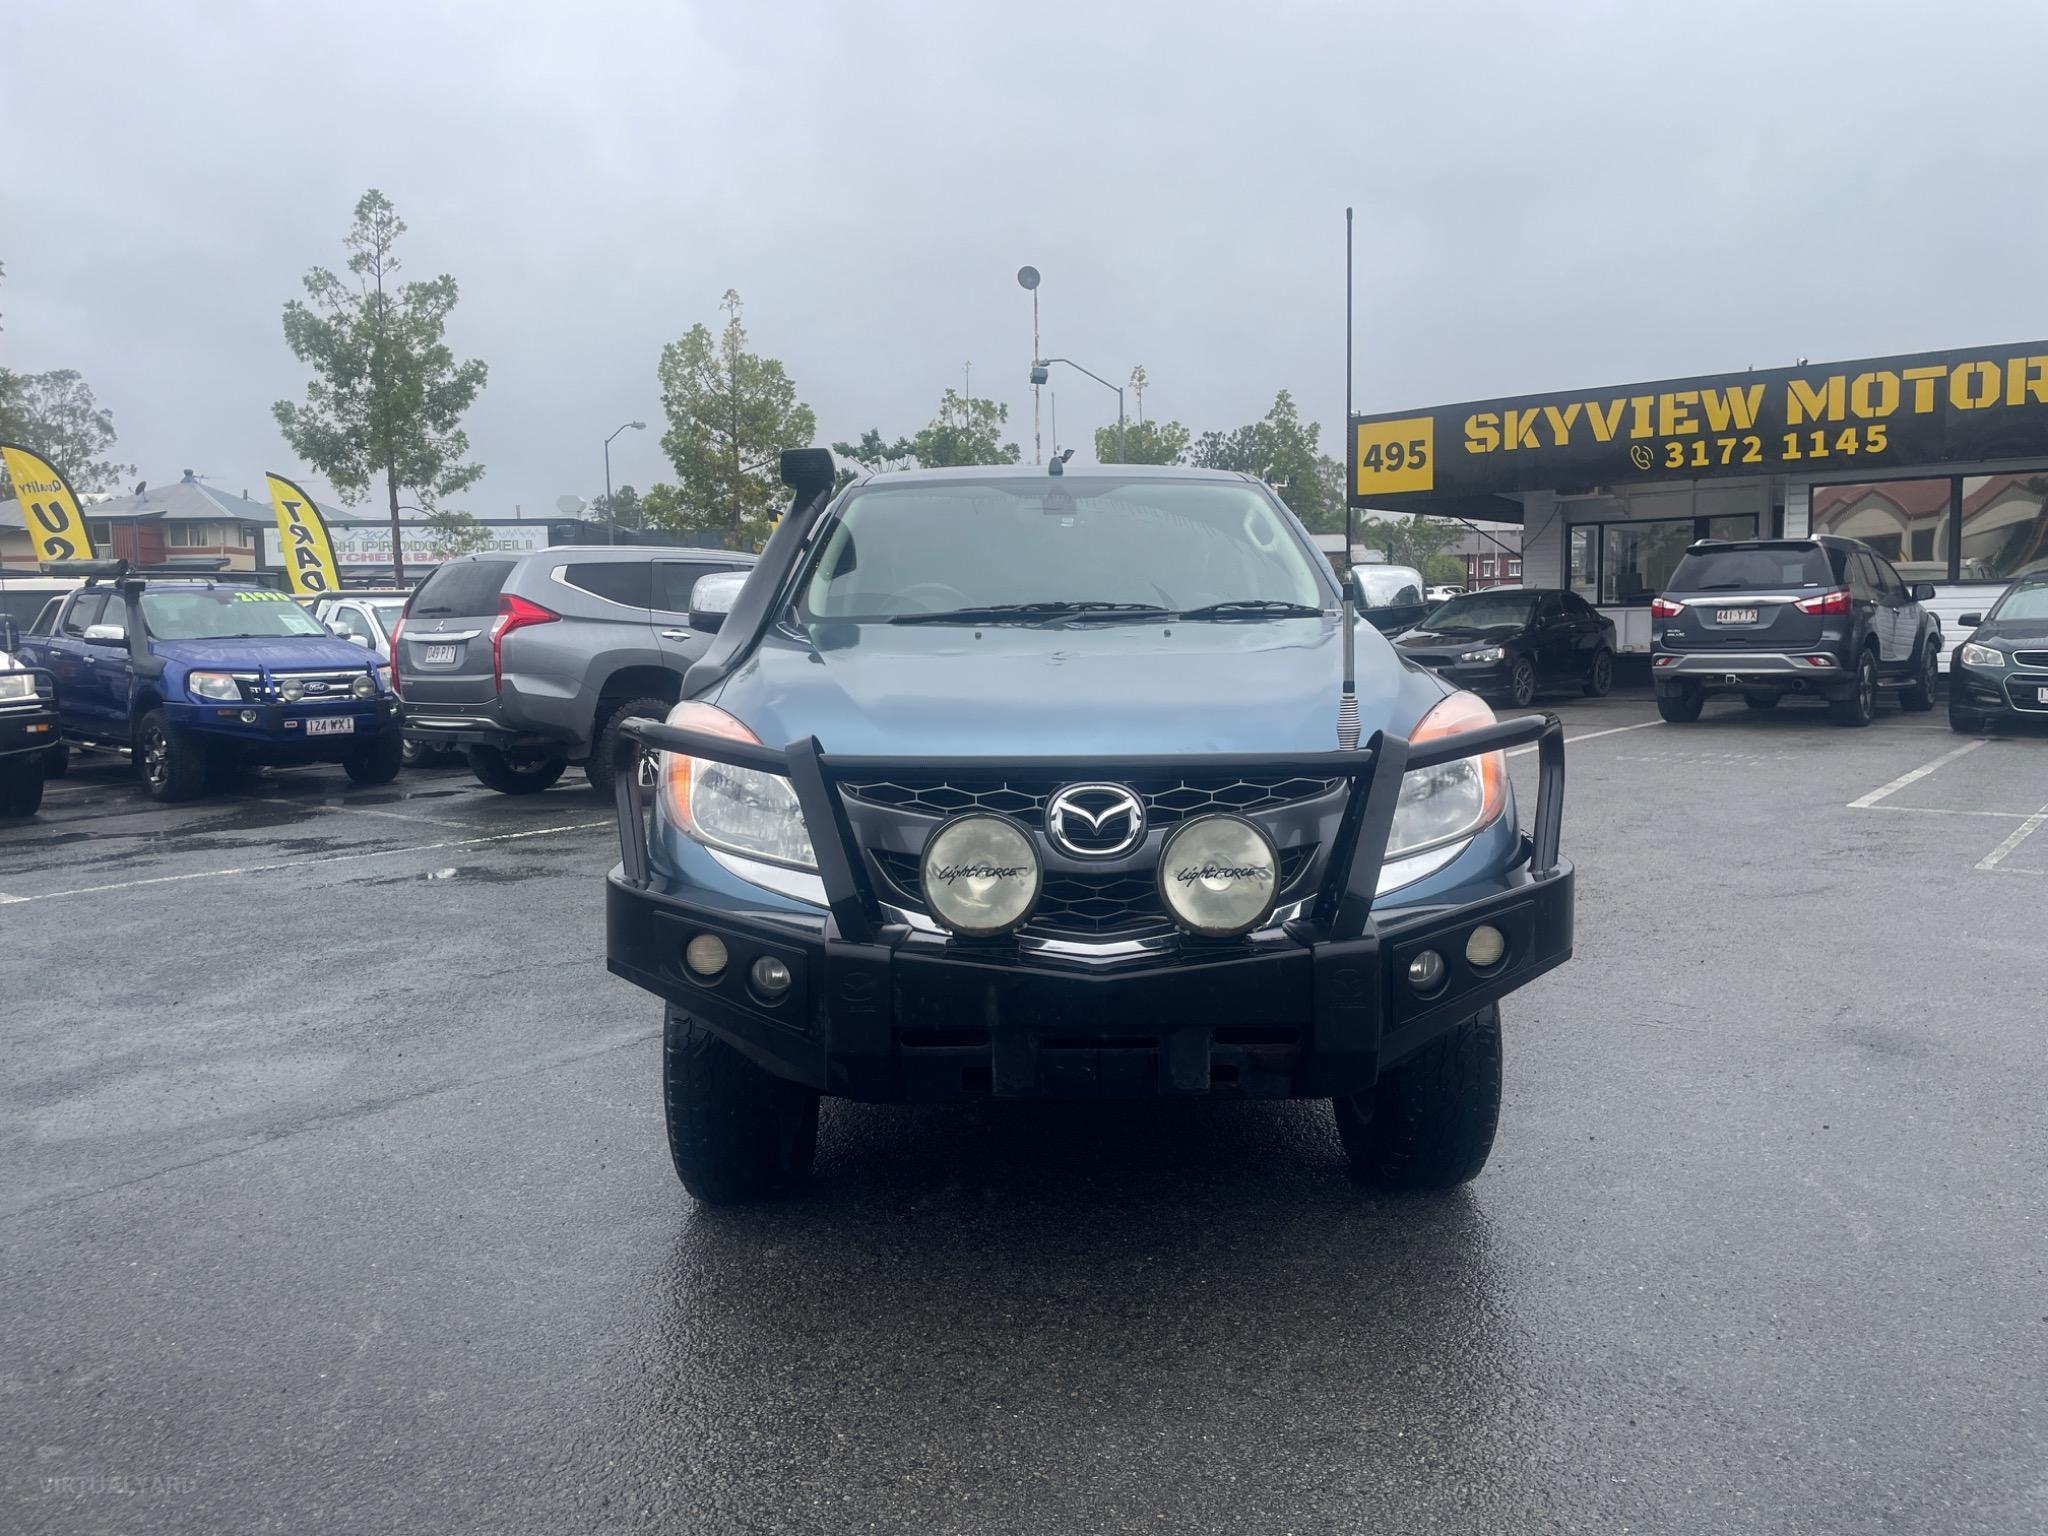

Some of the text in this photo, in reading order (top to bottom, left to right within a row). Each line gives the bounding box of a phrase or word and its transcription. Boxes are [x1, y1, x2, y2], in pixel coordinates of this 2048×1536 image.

[1464, 384, 1766, 454] SKYVIEW
[1363, 439, 1427, 473] 495
[1664, 425, 1888, 468] 3172 1145
[486, 539, 533, 551] DELI
[310, 720, 327, 732] 124
